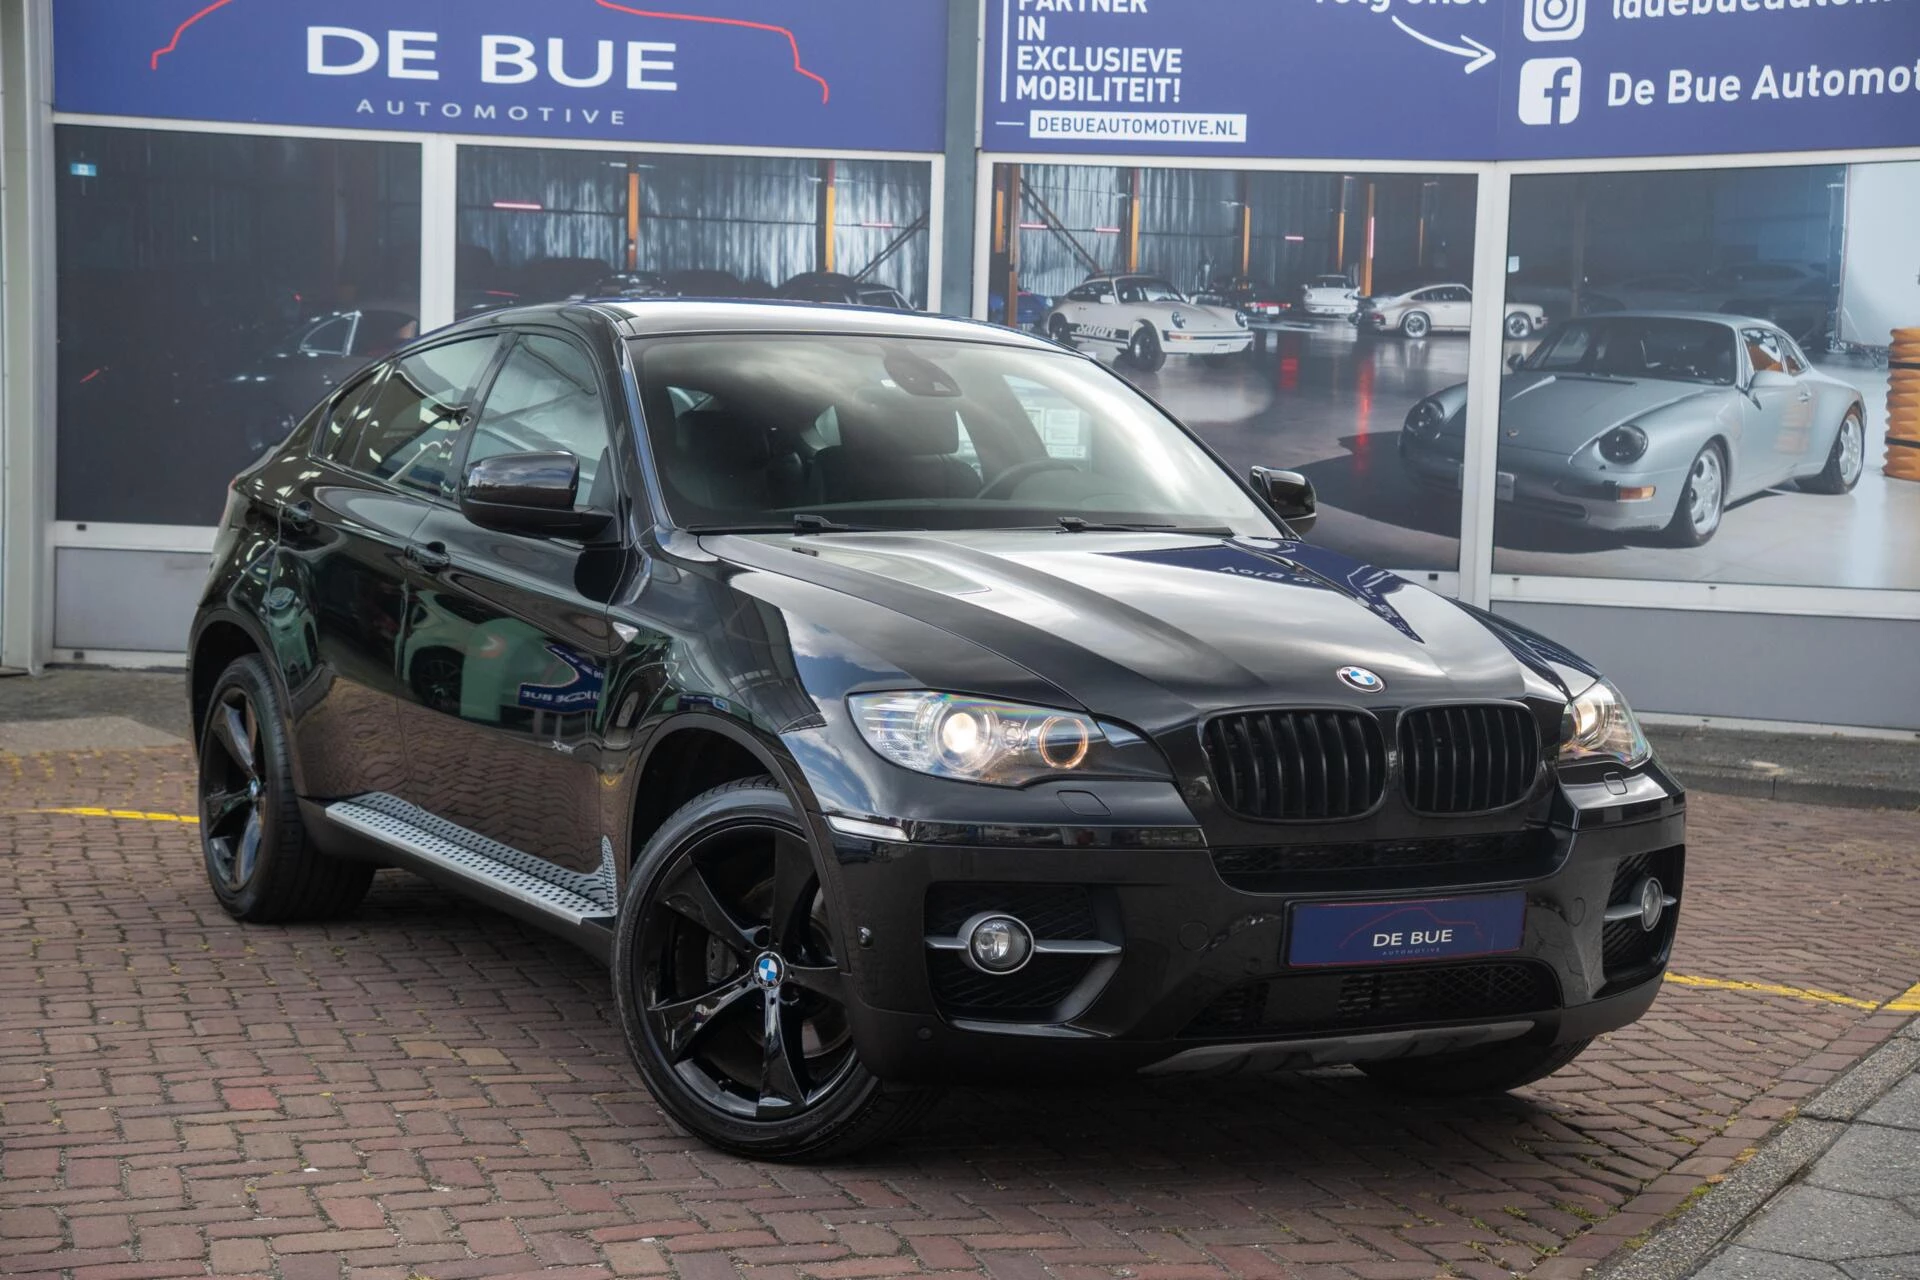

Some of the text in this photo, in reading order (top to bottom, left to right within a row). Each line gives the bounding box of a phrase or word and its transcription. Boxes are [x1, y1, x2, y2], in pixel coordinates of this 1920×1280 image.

[1017, 16, 1046, 41] IN
[307, 26, 678, 91] DE BUE
[1017, 46, 1182, 73] EXCLUSIEVE
[1016, 75, 1181, 102] MOBILITEIT!
[1607, 72, 1655, 107] De
[1667, 69, 1740, 104] Bue
[356, 99, 625, 125] AUTOMOTIVE
[1037, 116, 1238, 136] DEBUEAUTOMOTIVE.NL
[1373, 929, 1453, 947] DE BUE
